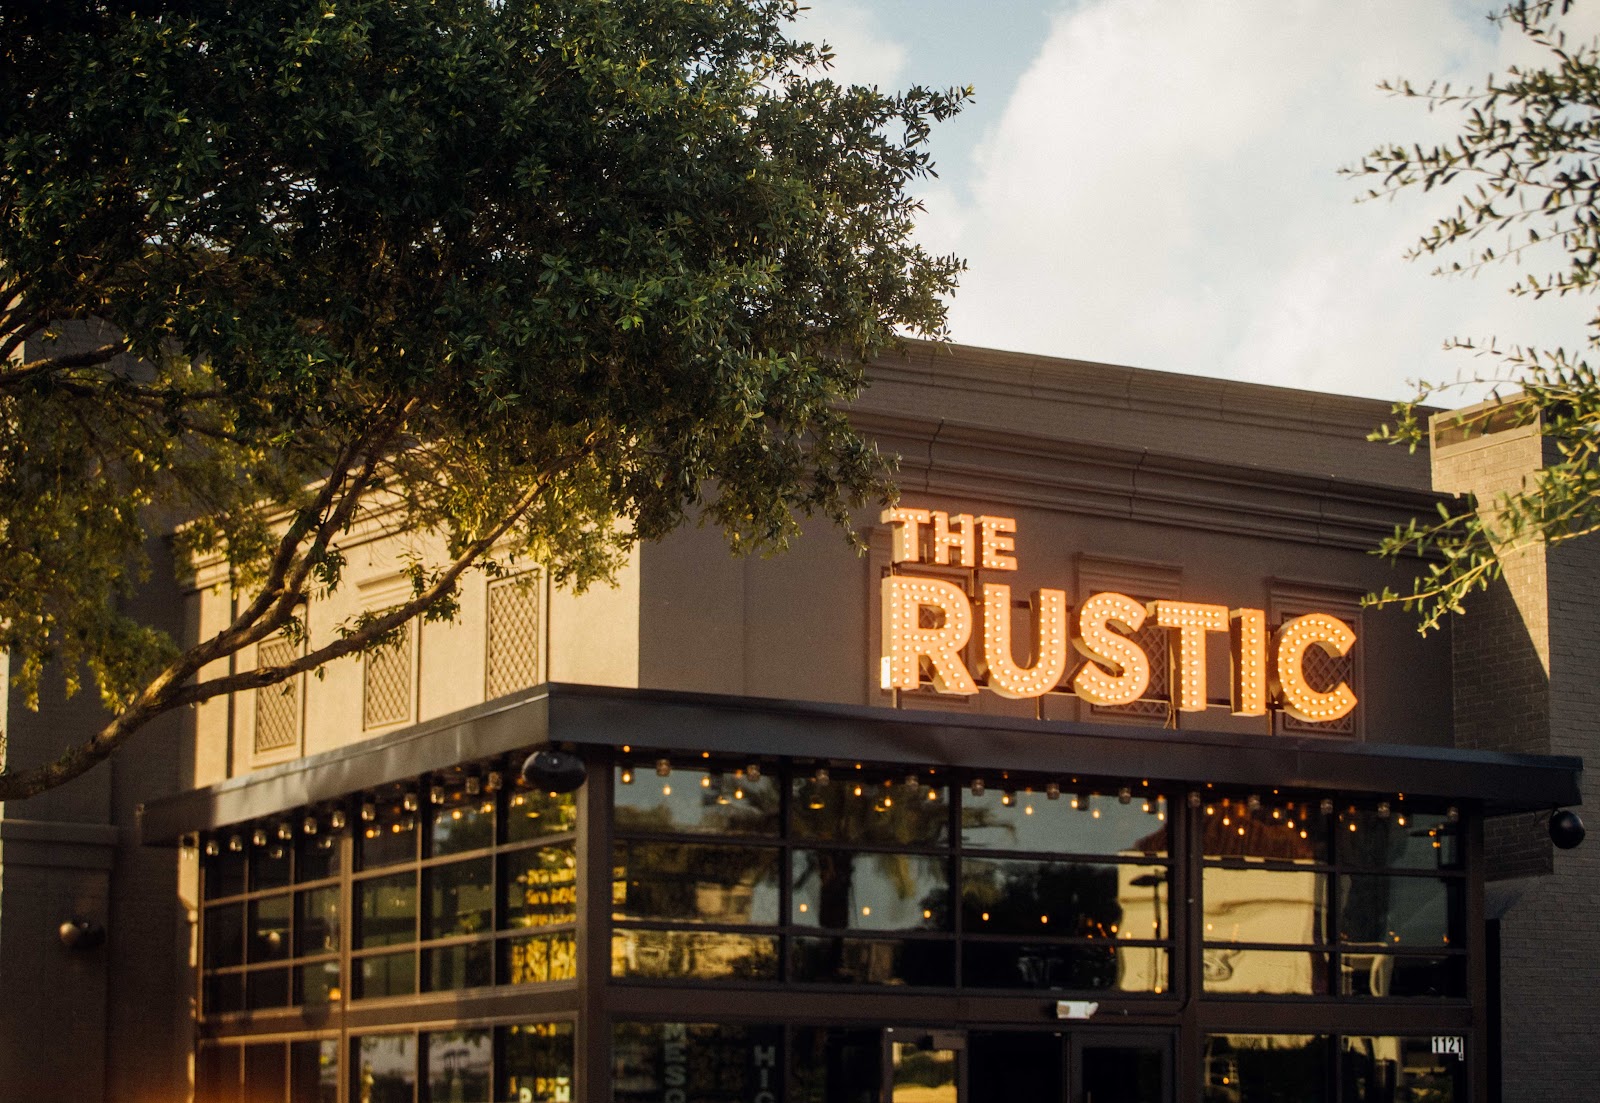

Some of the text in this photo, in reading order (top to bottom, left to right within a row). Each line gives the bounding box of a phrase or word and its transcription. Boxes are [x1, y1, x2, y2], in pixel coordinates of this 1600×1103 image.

[881, 507, 1017, 571] THE
[881, 576, 1358, 722] RUSTIC
[1433, 1036, 1462, 1053] 1121
